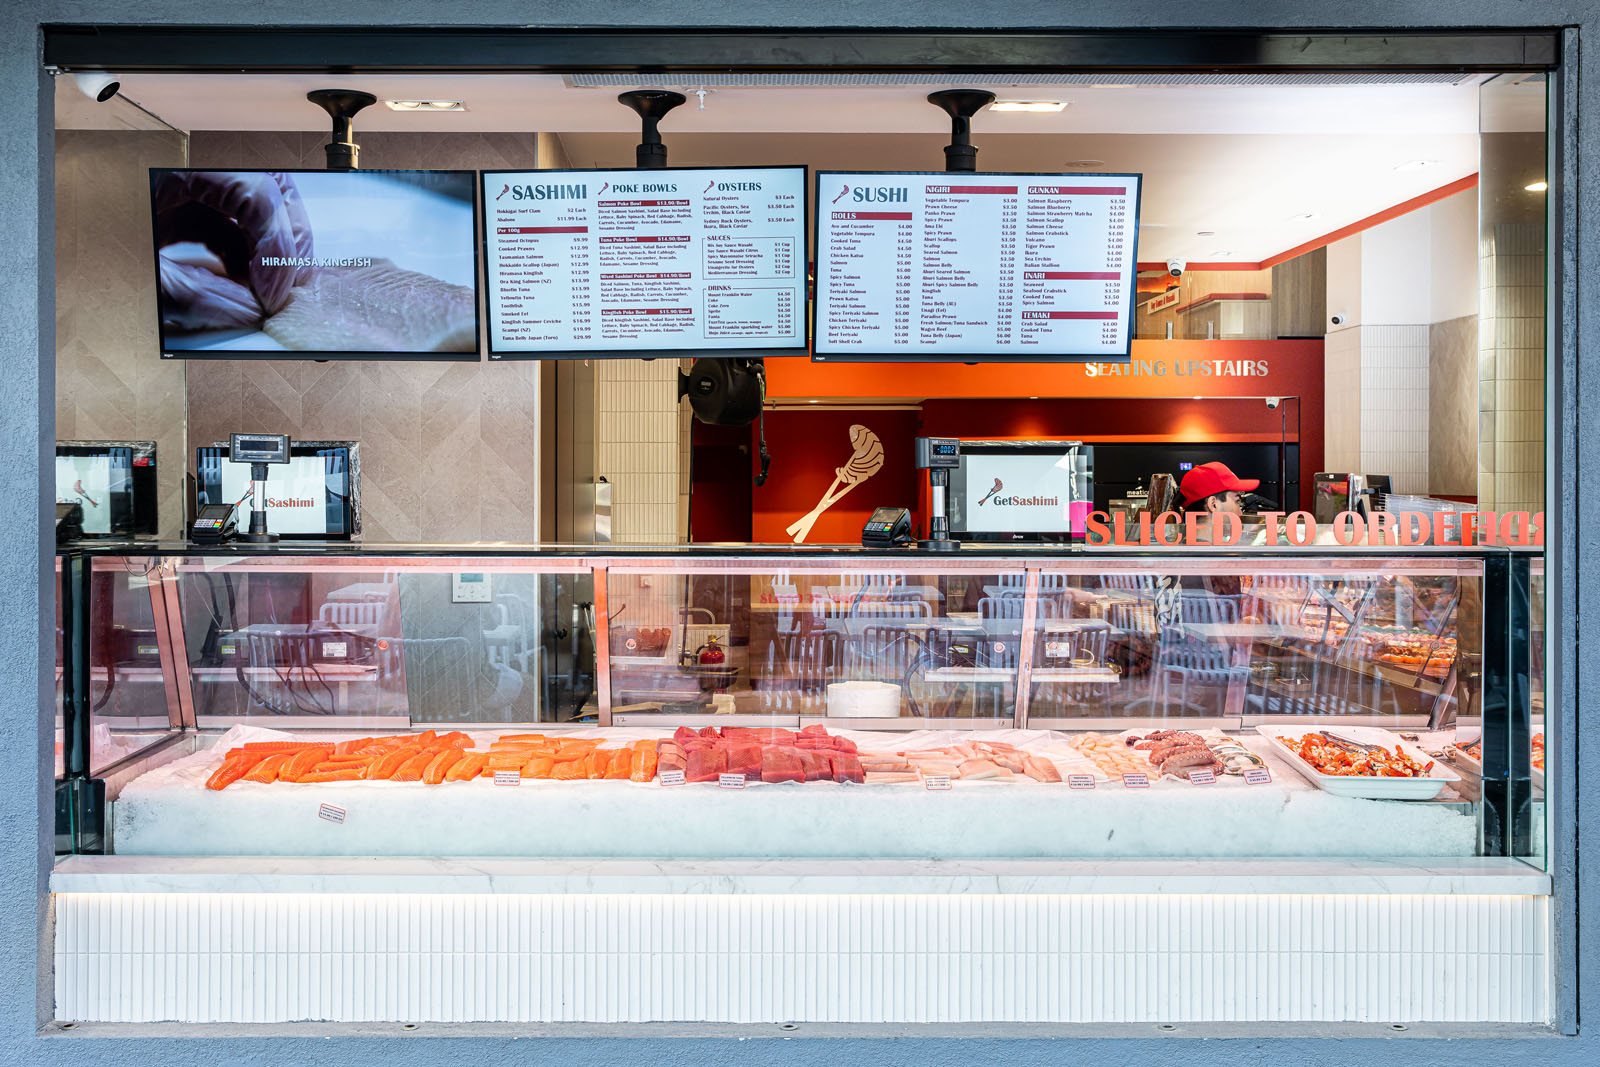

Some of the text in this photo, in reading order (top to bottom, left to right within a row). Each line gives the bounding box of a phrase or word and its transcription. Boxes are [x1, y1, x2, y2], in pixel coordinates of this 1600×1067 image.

[512, 184, 587, 200] SASHIMI
[612, 184, 677, 193] POKE BOWLS
[718, 182, 762, 191] OYSTERS
[853, 187, 908, 202] SUSHI
[262, 257, 372, 267] HIRAMASA KINGFISH
[1085, 360, 1269, 377] SEATING UPSTAIRS
[993, 496, 1058, 506] GetSashimi
[1086, 511, 1242, 546] SLICED
[1257, 511, 1317, 546] TO
